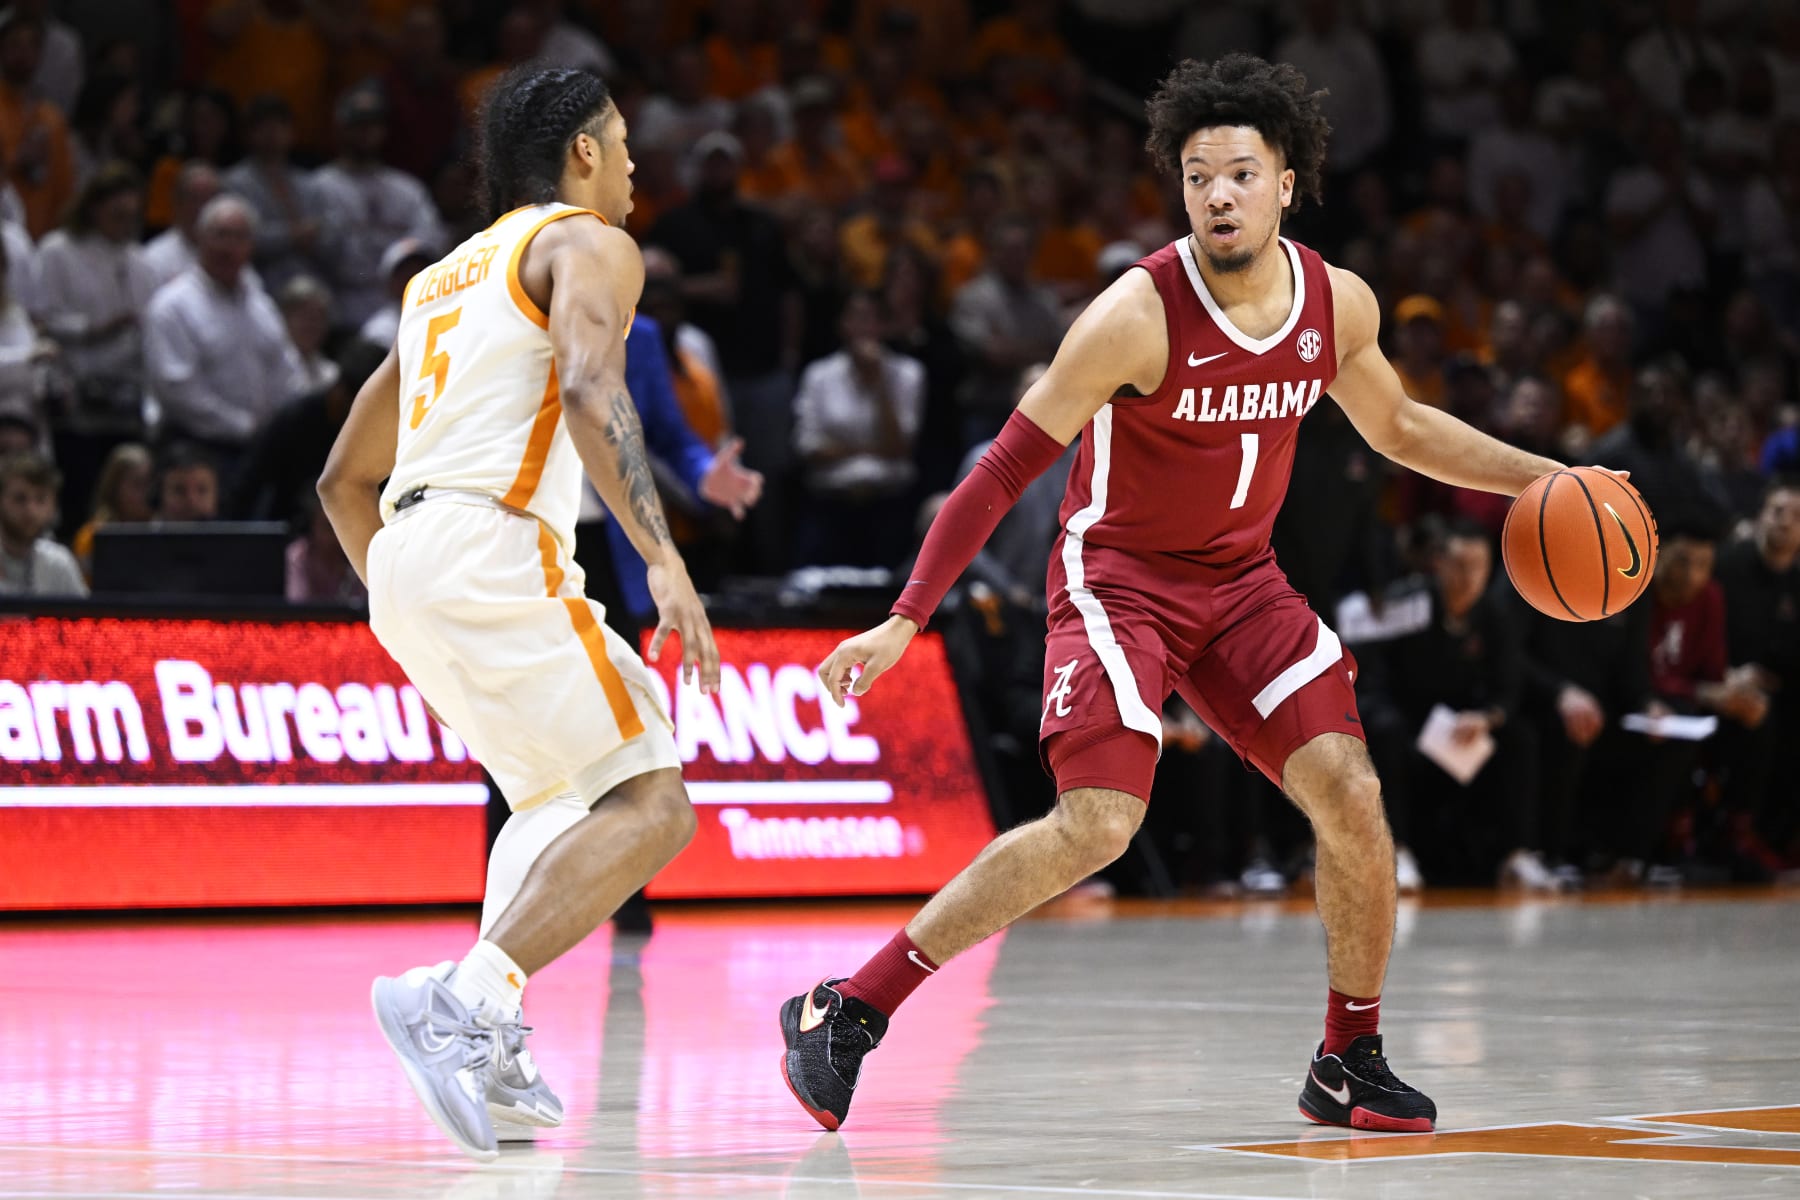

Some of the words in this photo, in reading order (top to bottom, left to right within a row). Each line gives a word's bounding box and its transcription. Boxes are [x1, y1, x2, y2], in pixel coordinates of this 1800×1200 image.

[416, 244, 500, 307] ZEIGLER
[409, 305, 463, 430] 5
[1299, 330, 1320, 362] SEC
[1171, 379, 1322, 422] ALABAMA
[1229, 433, 1259, 510] 1
[154, 660, 434, 762] Bureau
[1046, 659, 1079, 718] A
